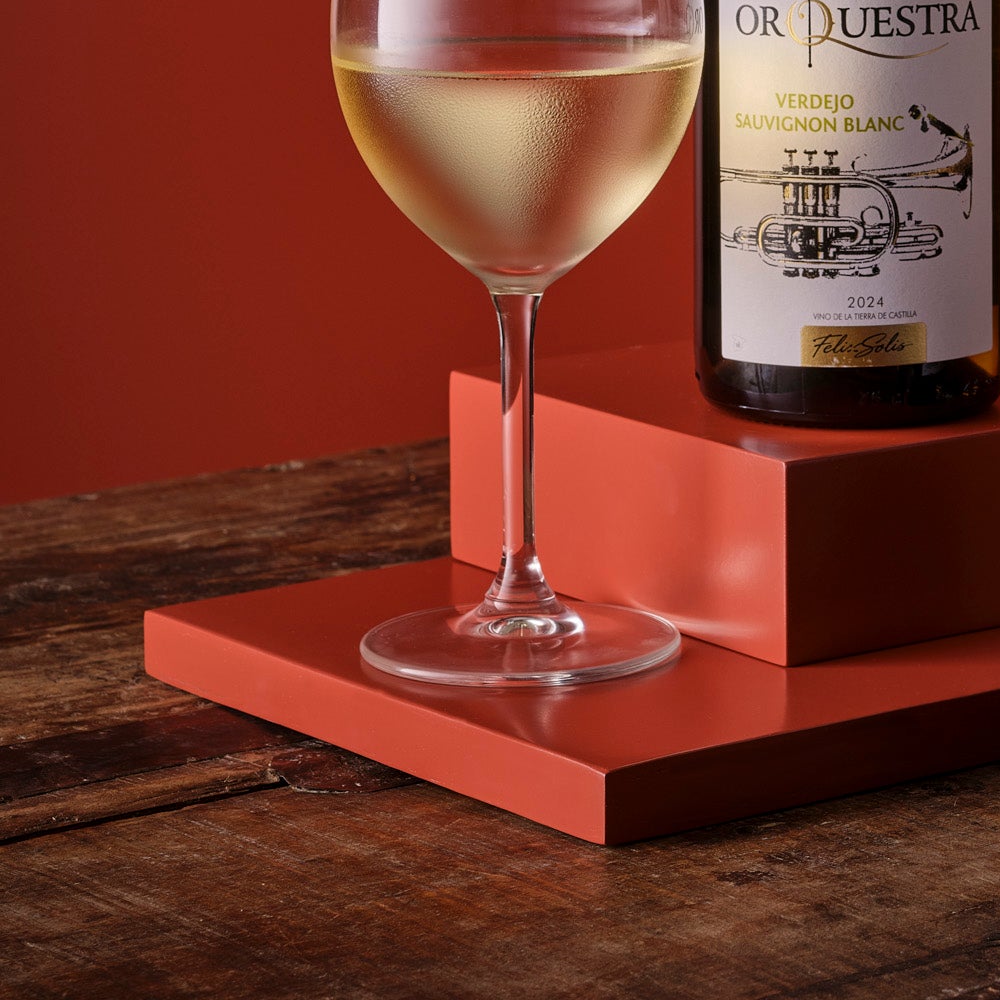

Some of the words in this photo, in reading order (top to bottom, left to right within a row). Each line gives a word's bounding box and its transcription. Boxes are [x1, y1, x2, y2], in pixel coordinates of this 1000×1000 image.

[735, 0, 980, 60] ORQUESTRA
[775, 93, 854, 113] VERDEJO
[735, 113, 837, 132] SAUVIGNON
[844, 116, 905, 132] BLANC
[847, 296, 884, 308] 2024
[813, 312, 831, 320] VINO
[833, 312, 843, 320] DE
[844, 312, 852, 320] LA
[854, 312, 876, 320] TIERRA
[878, 311, 887, 319] DE
[889, 310, 917, 319] CASTILLA
